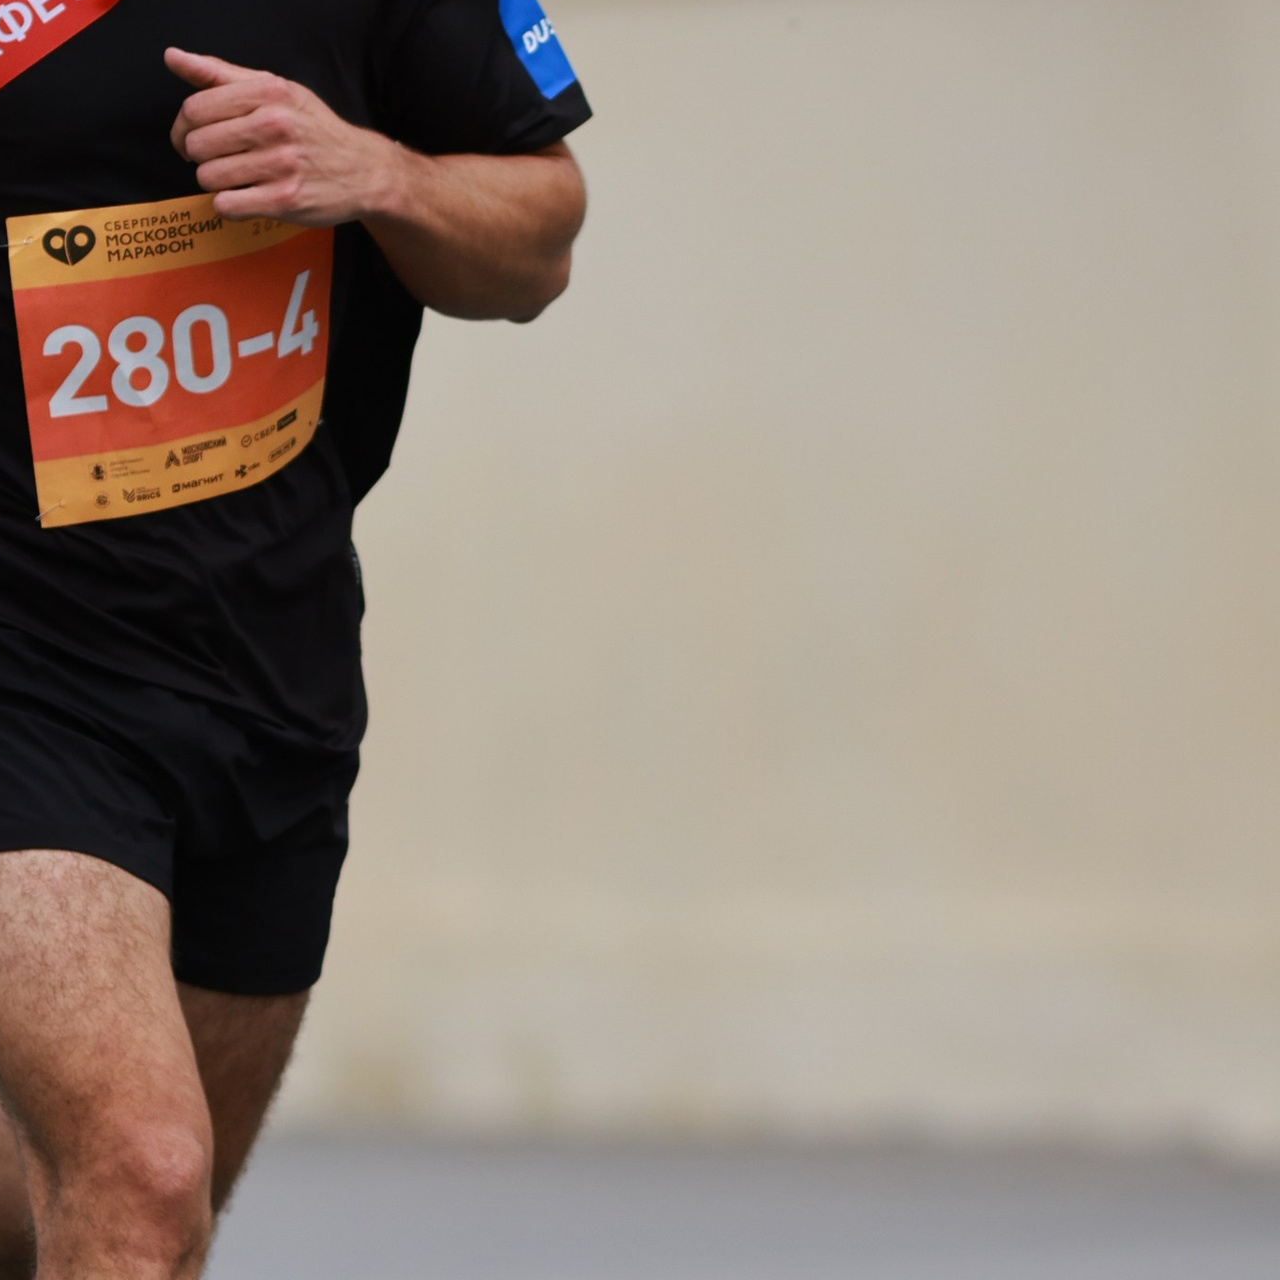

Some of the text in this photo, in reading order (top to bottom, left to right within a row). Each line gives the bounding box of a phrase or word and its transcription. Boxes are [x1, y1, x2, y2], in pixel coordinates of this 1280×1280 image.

[104, 211, 191, 232] СБЕРПРАЙМ
[106, 217, 223, 247] МОСКОВСКИЙ
[107, 238, 194, 262] МАРАФОН
[42, 270, 318, 418] 280-4
[254, 425, 276, 442] СБЕР
